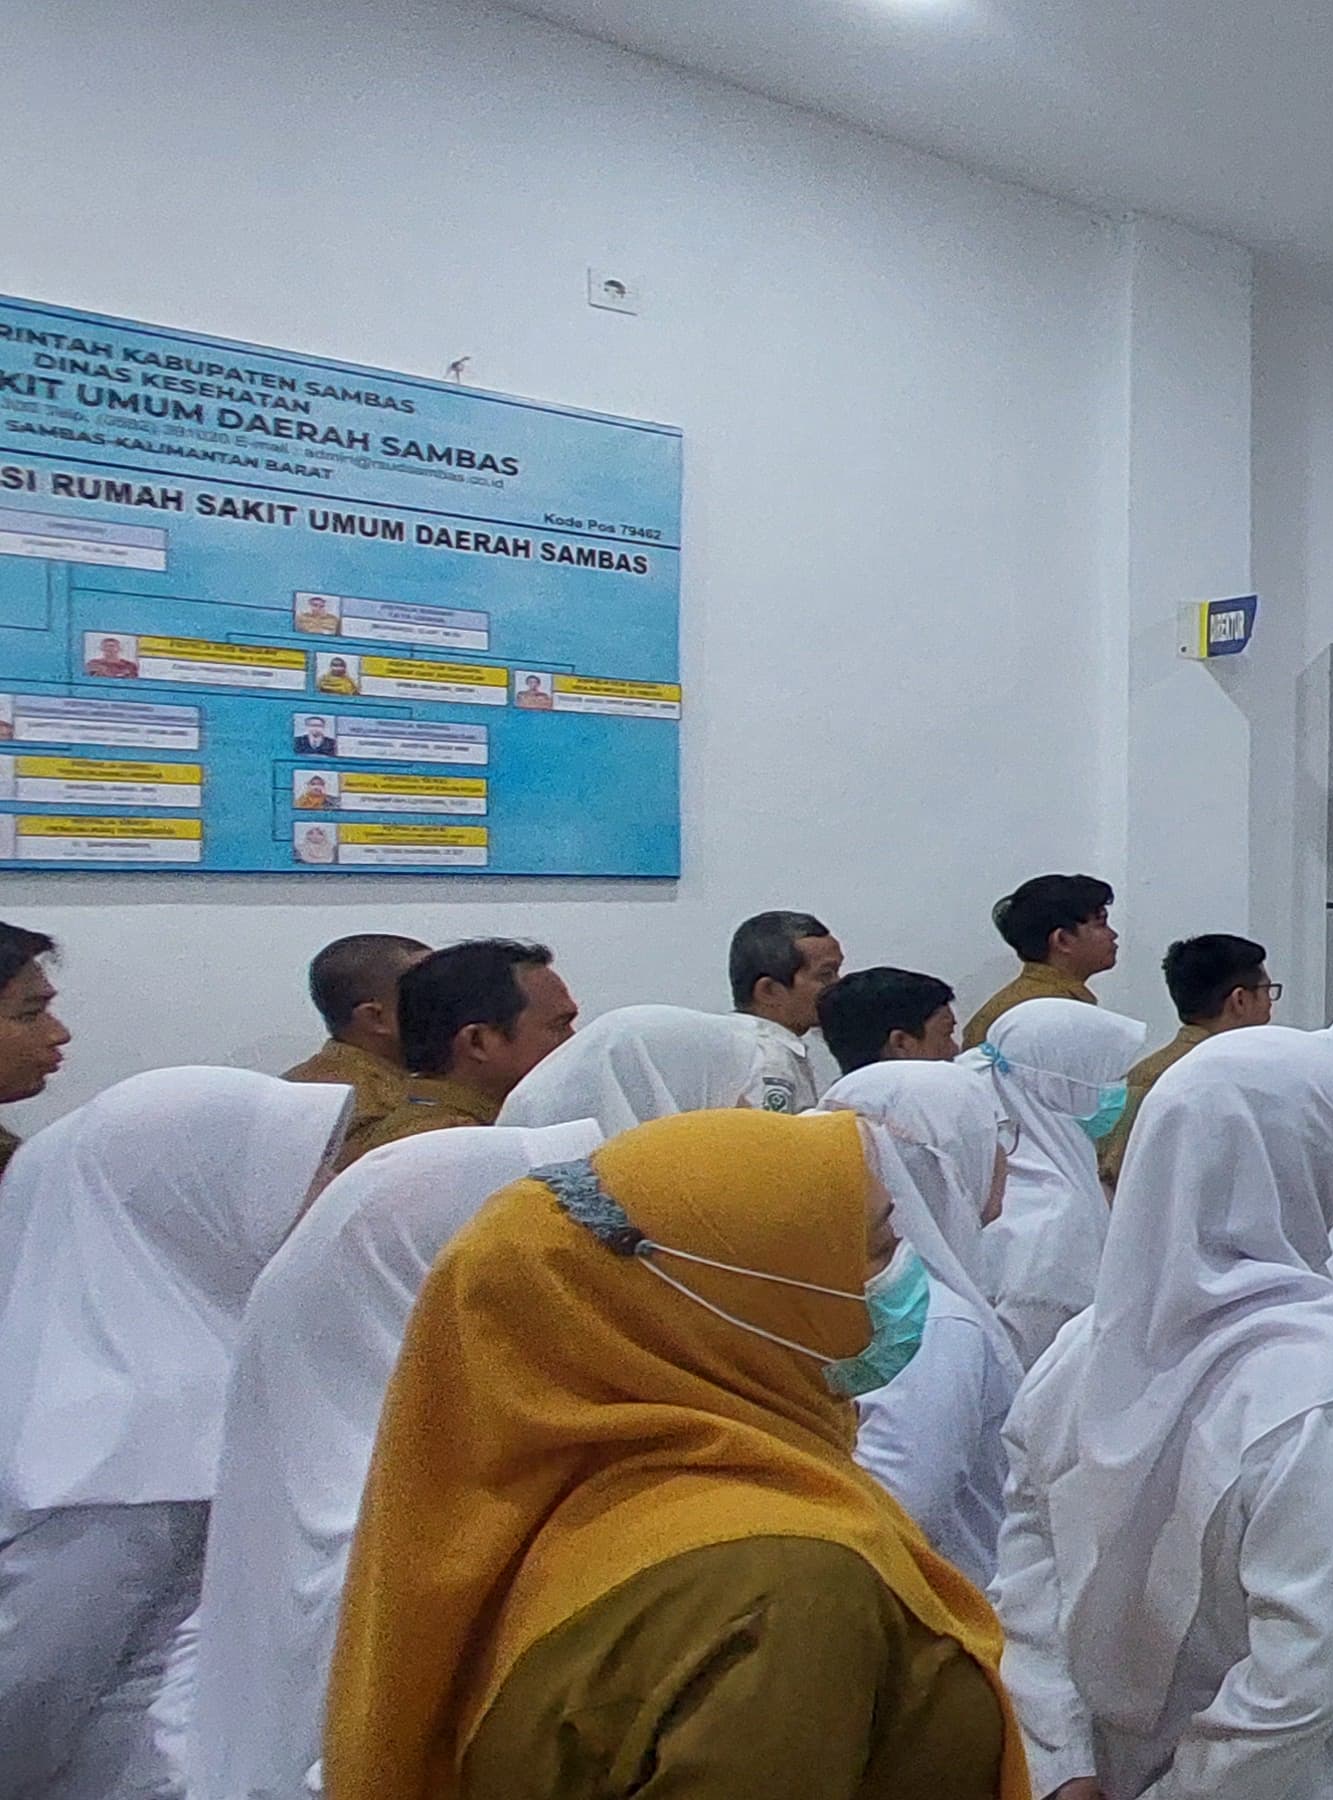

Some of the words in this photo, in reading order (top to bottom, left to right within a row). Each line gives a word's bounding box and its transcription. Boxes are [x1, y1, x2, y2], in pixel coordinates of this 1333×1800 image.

[33, 352, 132, 384] DINAS
[141, 371, 311, 415] KESEHATAN
[122, 347, 297, 392] KABUPATEN
[304, 381, 416, 414] SAMBAS
[4, 419, 259, 470] SAMBAS-KALIMANTAN
[264, 458, 336, 481] BARAT
[77, 382, 205, 426] UMUM
[217, 407, 370, 452] DAERAH
[380, 435, 520, 477] SAMBAS
[0, 465, 37, 493] SI
[50, 472, 185, 512] RUMAH
[196, 492, 299, 526] SAKIT
[308, 508, 405, 543] UMUM
[415, 524, 532, 559] DAERAH
[540, 541, 649, 575] SAMBAS
[543, 512, 584, 529] Kode
[588, 519, 616, 535] Pos
